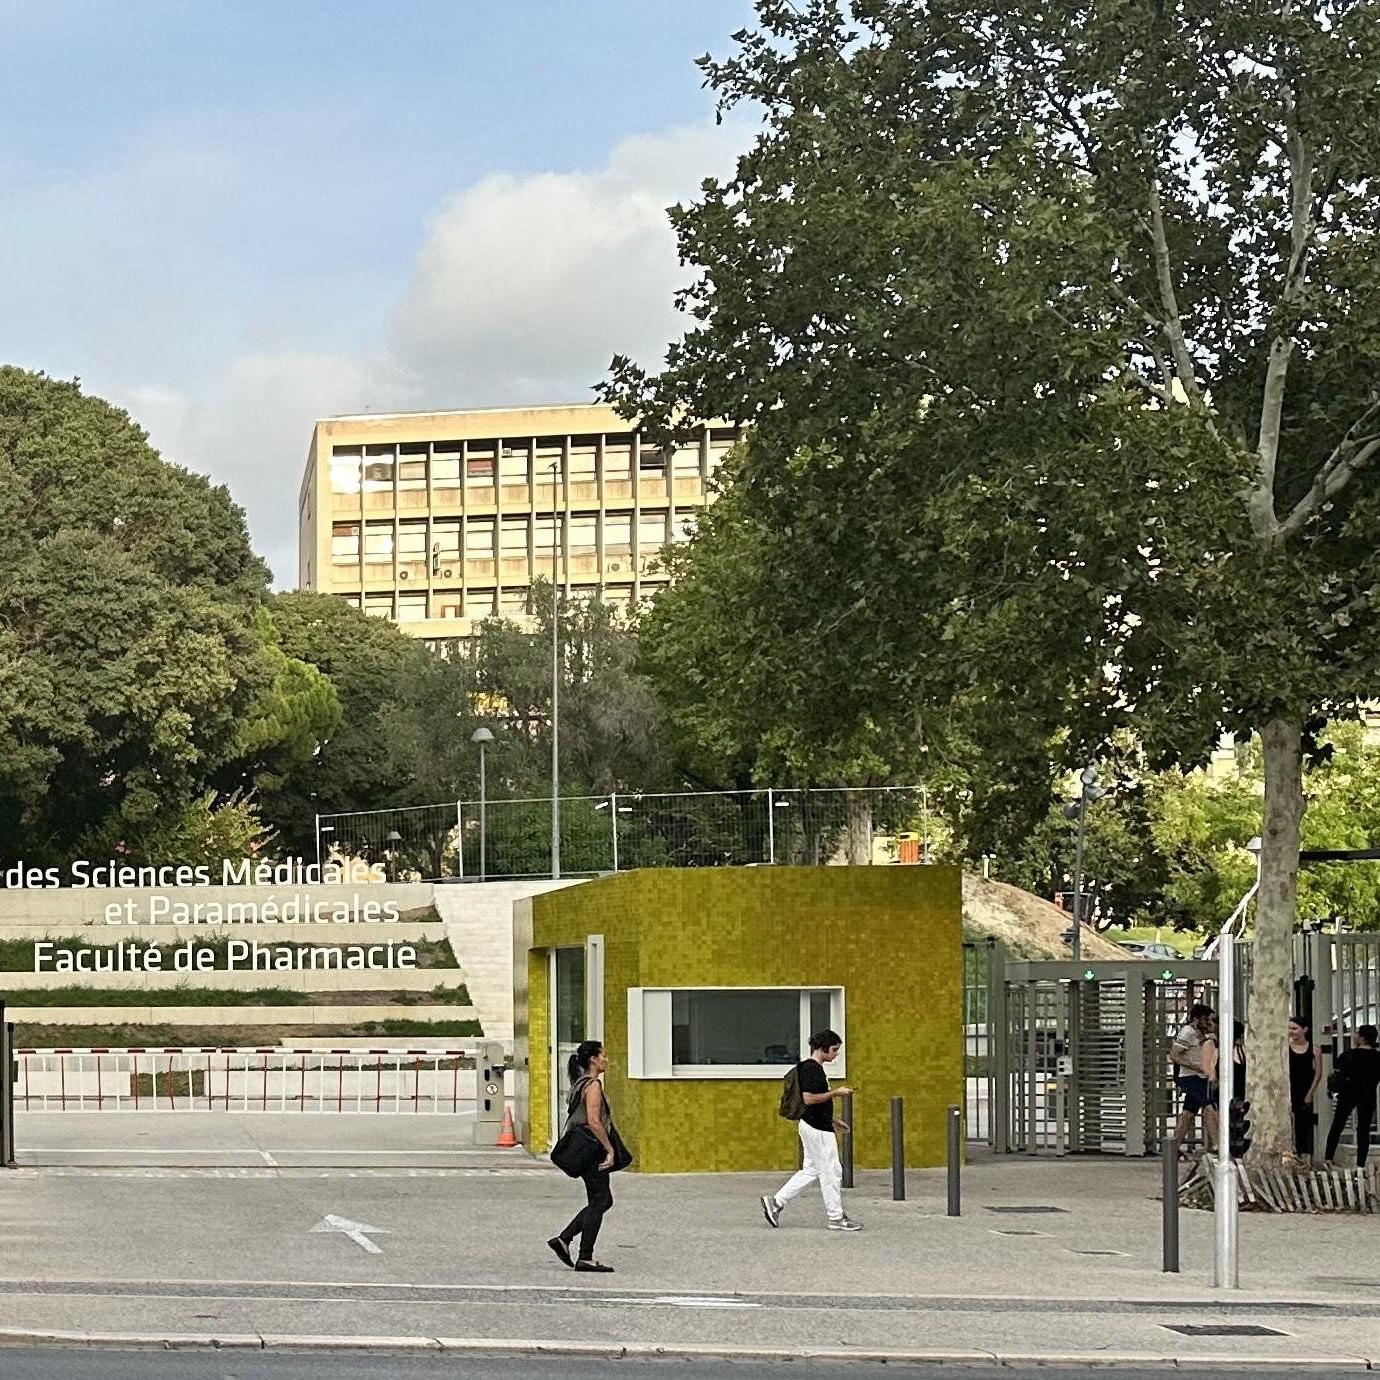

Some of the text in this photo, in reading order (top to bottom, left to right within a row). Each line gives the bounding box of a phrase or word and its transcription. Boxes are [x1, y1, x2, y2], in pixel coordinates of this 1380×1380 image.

[5, 861, 60, 889] des
[71, 860, 210, 888] Sciences
[222, 857, 387, 886] Médicales
[104, 894, 400, 926] et Paramédicales
[34, 939, 417, 973] Faculté de Pharmacie
